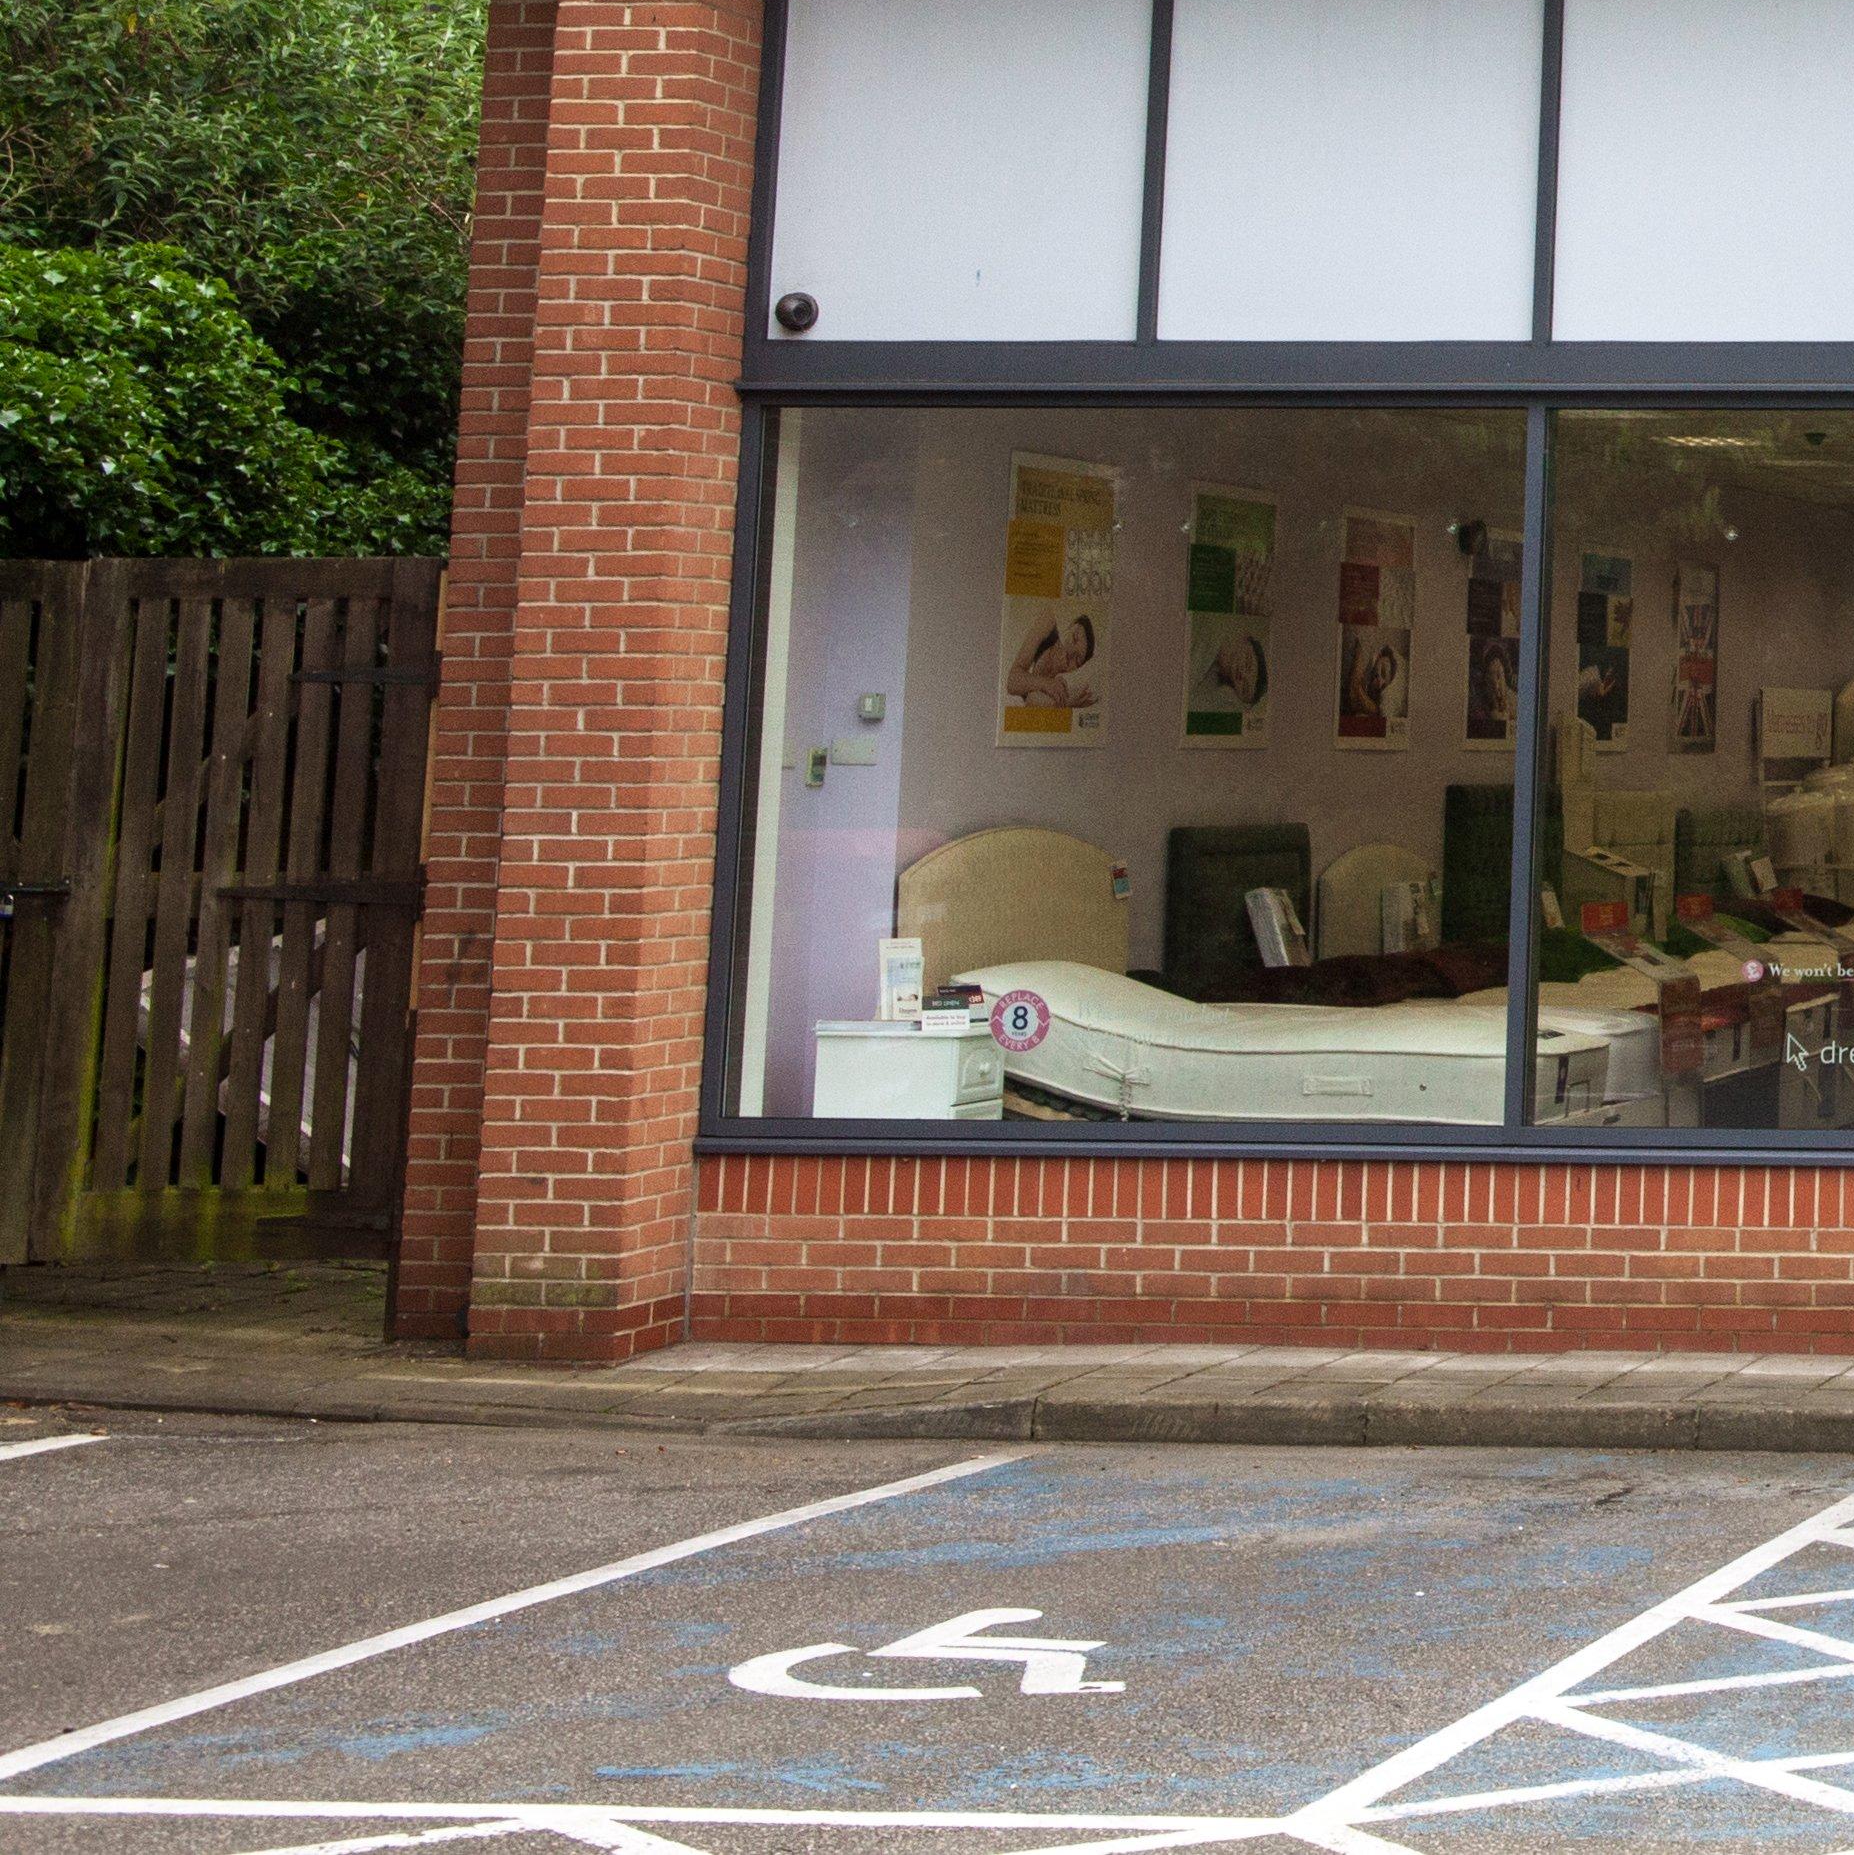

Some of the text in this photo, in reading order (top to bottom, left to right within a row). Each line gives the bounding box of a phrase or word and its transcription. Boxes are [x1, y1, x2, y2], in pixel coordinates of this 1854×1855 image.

[1769, 963, 1790, 978] We
[1793, 963, 1834, 978] won't
[1837, 963, 1854, 978] be
[998, 992, 1045, 1010] REPLACE
[1012, 1005, 1028, 1031] 8
[998, 1034, 1029, 1050] EVERY
